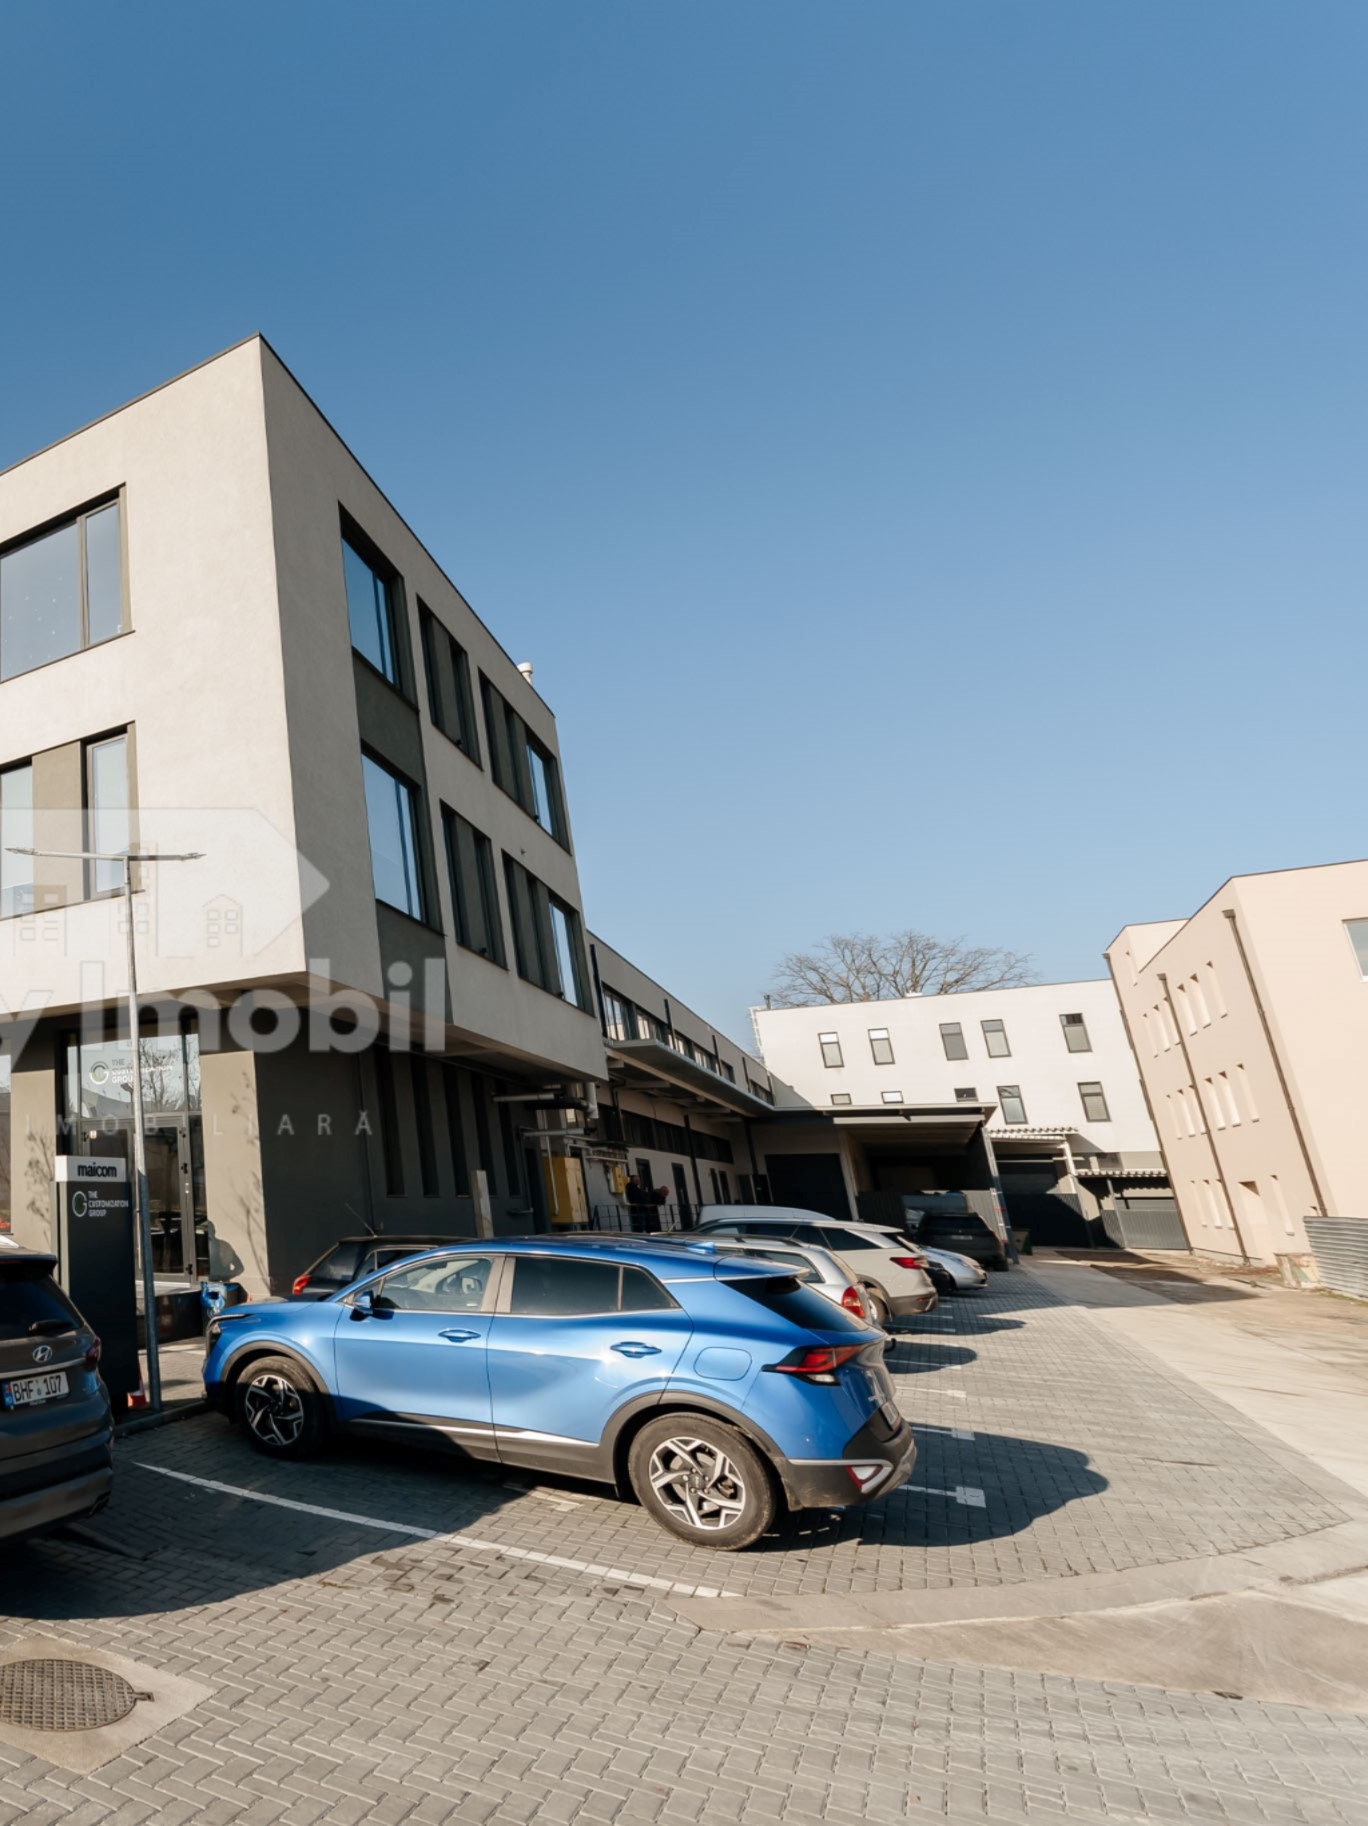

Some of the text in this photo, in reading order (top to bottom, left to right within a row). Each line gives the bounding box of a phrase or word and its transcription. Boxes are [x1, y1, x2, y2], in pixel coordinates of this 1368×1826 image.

[112, 1075, 133, 1084] GROU
[78, 1162, 117, 1177] maicom
[88, 1190, 99, 1199] THE
[88, 1209, 107, 1217] GROUP
[12, 1379, 34, 1402] BHF
[43, 1375, 62, 1396] 107
